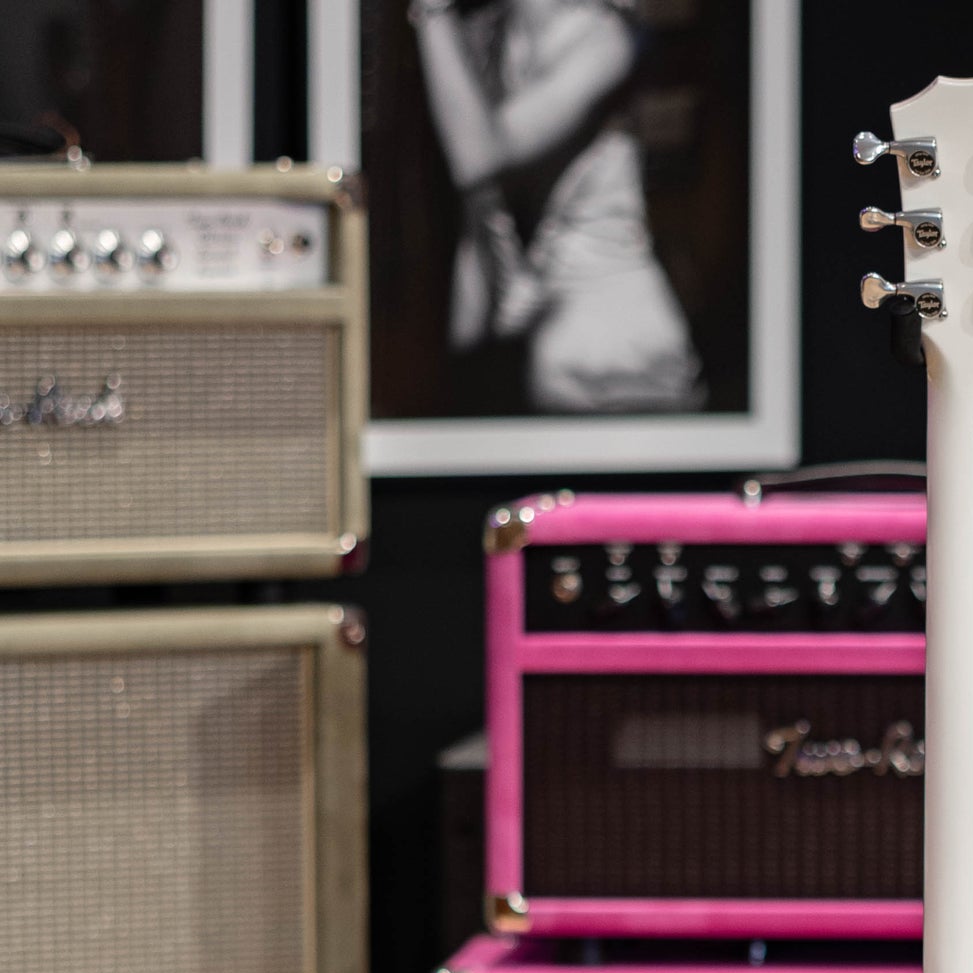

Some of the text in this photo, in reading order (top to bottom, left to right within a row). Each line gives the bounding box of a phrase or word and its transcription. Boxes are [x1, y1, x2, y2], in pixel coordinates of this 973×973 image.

[911, 157, 934, 168] Taylor
[917, 228, 939, 239] Taylor
[918, 299, 940, 310] Taylor
